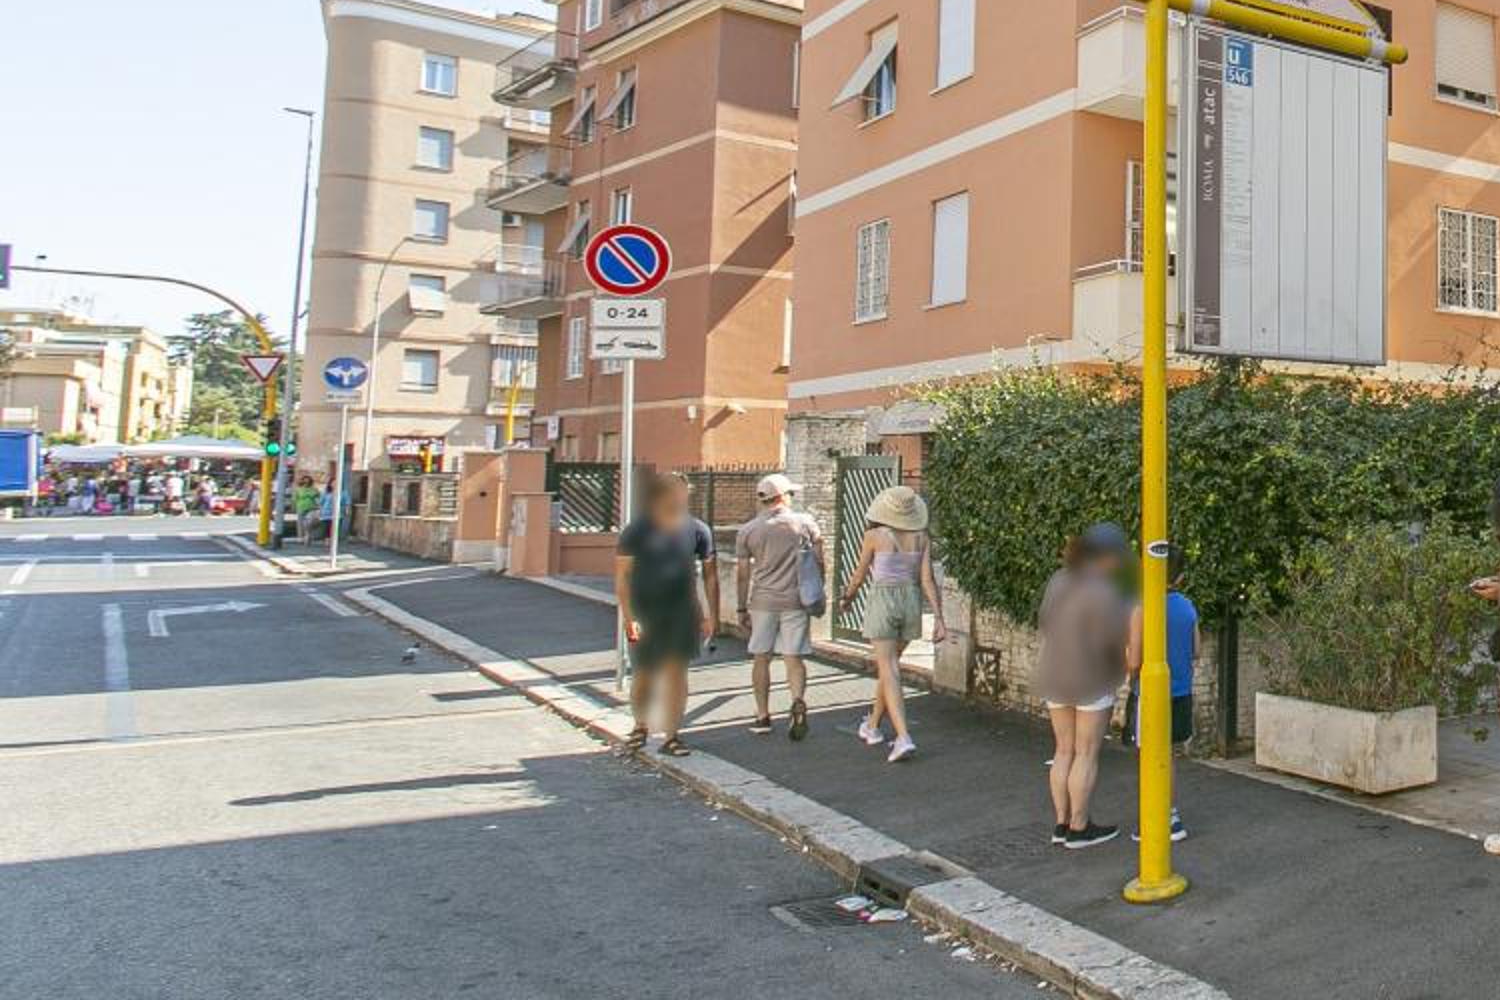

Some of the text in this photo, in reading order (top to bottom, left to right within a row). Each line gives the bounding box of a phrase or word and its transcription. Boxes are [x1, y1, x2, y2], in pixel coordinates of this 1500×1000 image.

[1228, 69, 1249, 85] 546
[1202, 87, 1217, 125] atac
[1202, 160, 1216, 201] ROMA
[607, 307, 649, 319] 0-24
